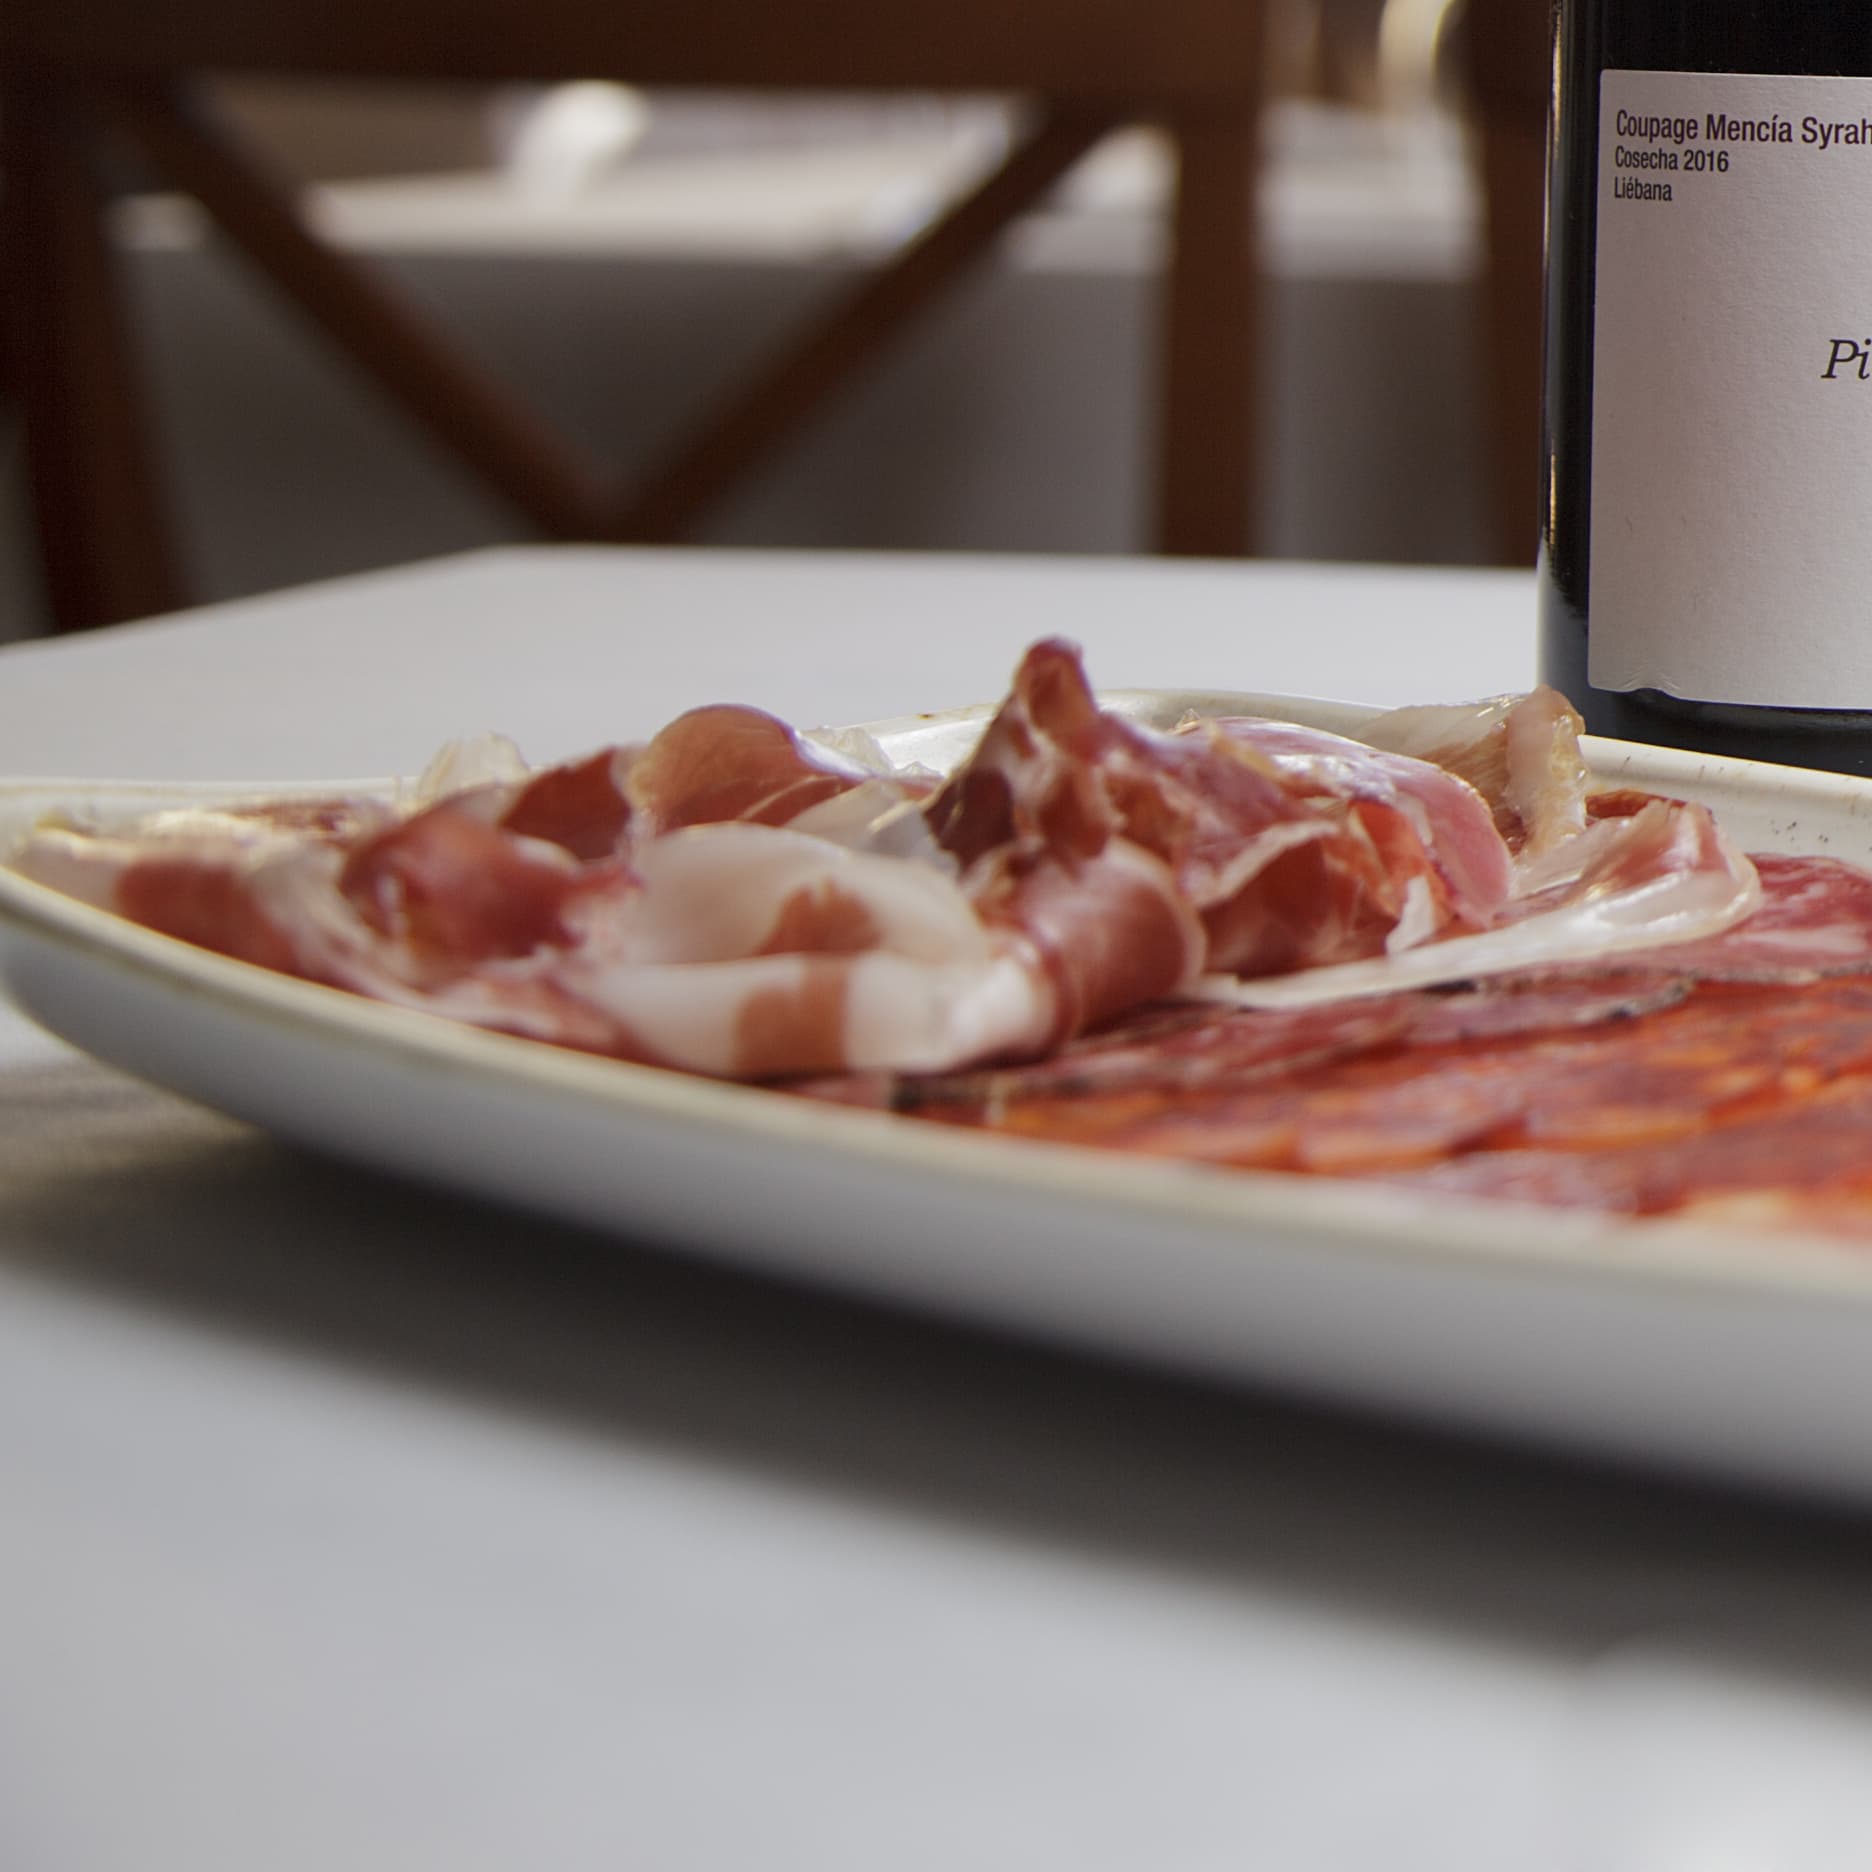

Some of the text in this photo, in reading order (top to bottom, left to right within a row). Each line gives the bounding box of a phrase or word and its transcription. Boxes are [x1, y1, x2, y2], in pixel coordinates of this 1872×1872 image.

[1615, 108, 1699, 145] Coupage
[1705, 113, 1793, 144] Mencía
[1614, 145, 1730, 173] Cosecha 2016
[1613, 176, 1673, 202] Liébana
